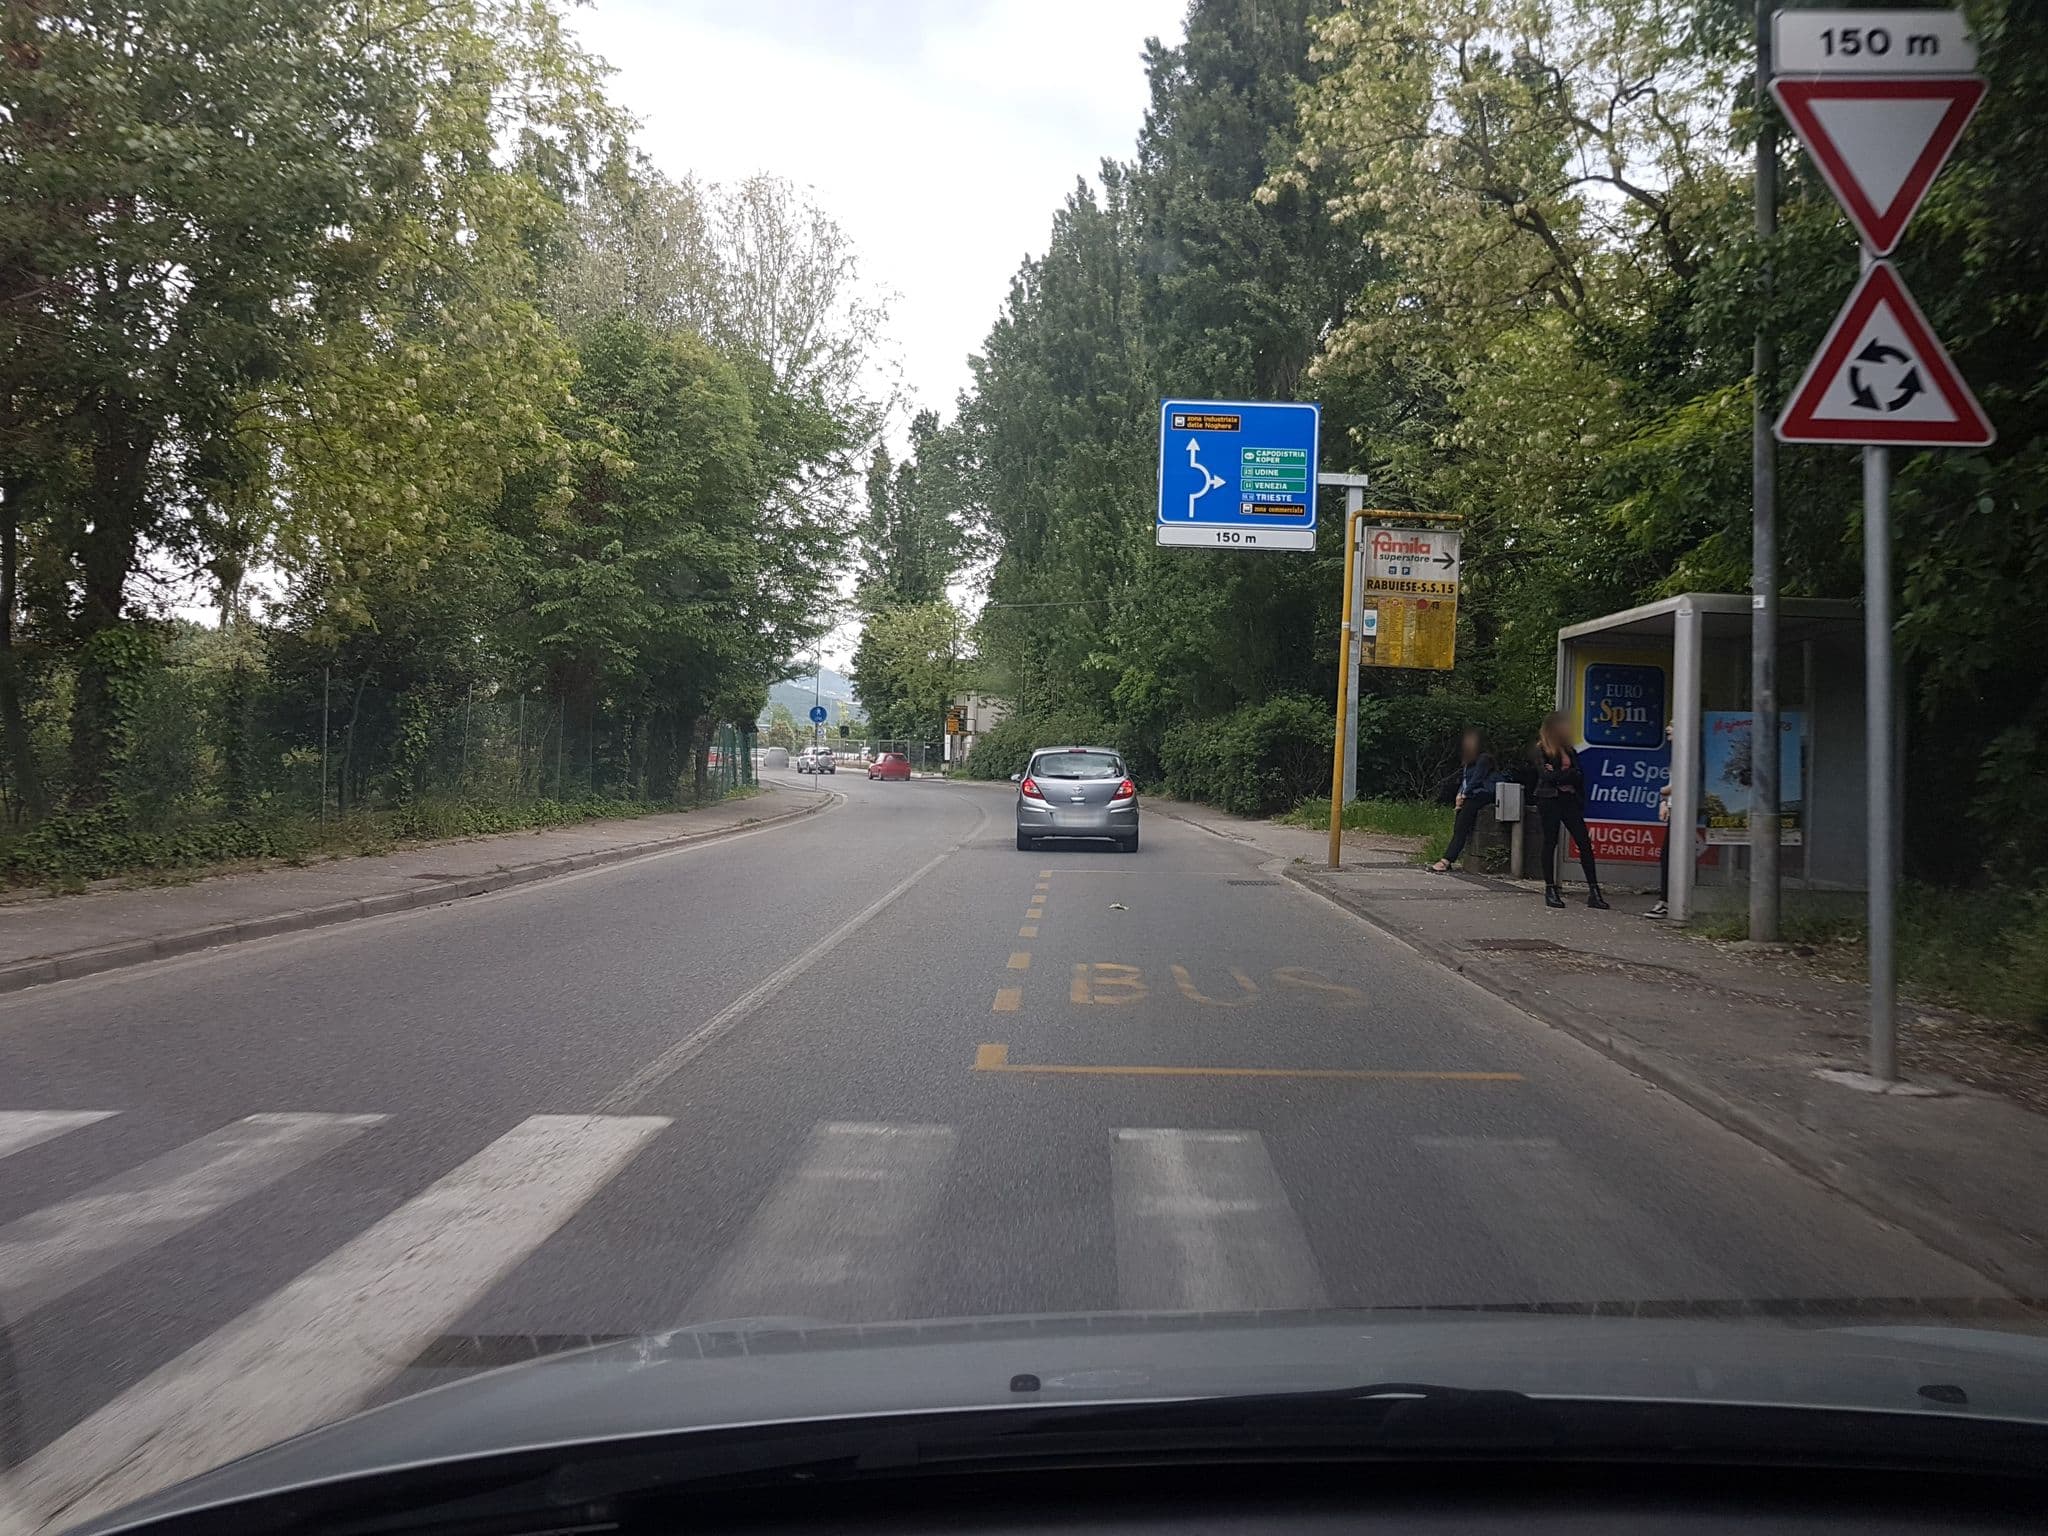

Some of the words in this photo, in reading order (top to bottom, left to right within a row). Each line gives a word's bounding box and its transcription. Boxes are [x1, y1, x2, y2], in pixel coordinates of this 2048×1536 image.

[1819, 28, 1891, 56] 150
[1905, 33, 1940, 56] m
[1254, 482, 1287, 490] VENEZIA
[1256, 493, 1292, 502] TRIESTE
[1216, 532, 1240, 543] 150
[1245, 535, 1256, 544] m
[1371, 531, 1431, 559] famila
[1379, 553, 1430, 562] superstore
[1606, 684, 1643, 698] EURO
[1600, 698, 1649, 727] Spin
[1601, 759, 1626, 777] La
[1600, 844, 1645, 857] FARNEI
[1070, 962, 1370, 1008] BUS
